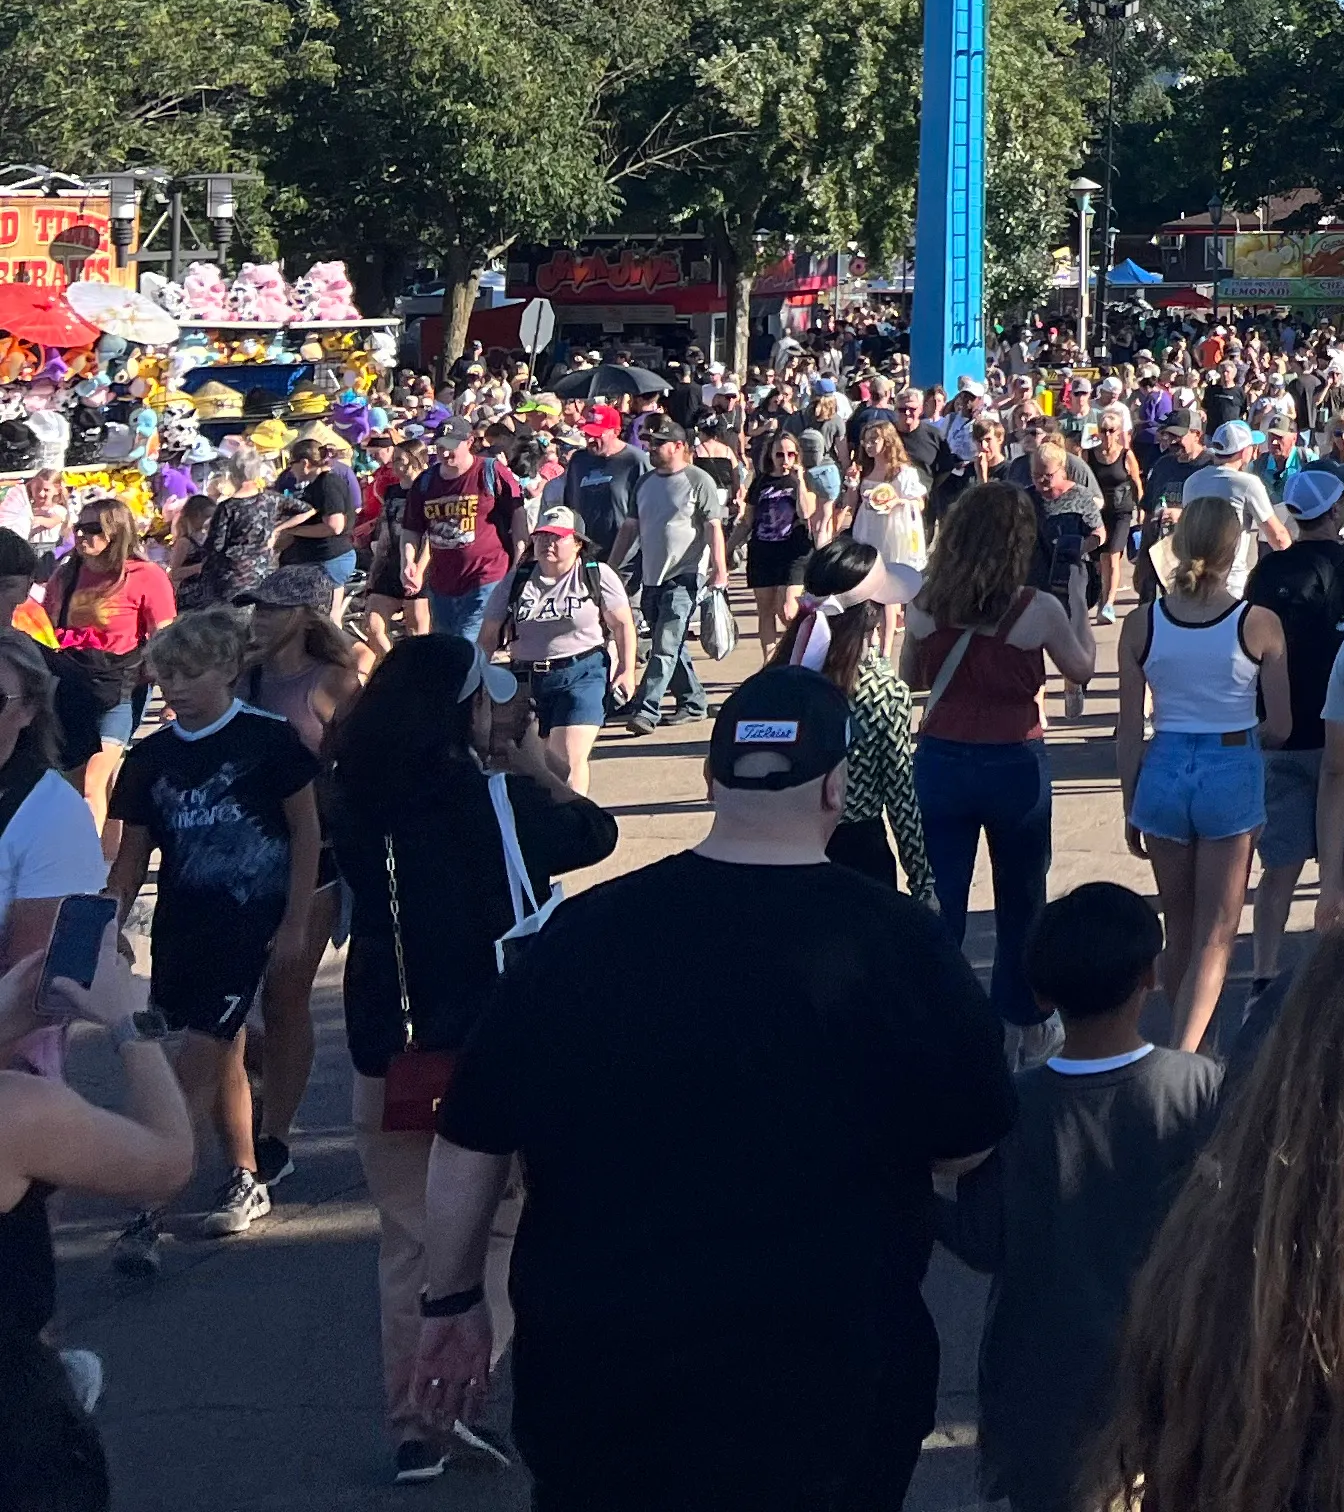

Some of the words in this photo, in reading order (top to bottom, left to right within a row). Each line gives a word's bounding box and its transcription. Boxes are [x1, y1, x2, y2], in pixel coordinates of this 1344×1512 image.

[515, 596, 584, 623] GAP
[740, 723, 792, 740] Titleist
[219, 994, 241, 1024] 7
